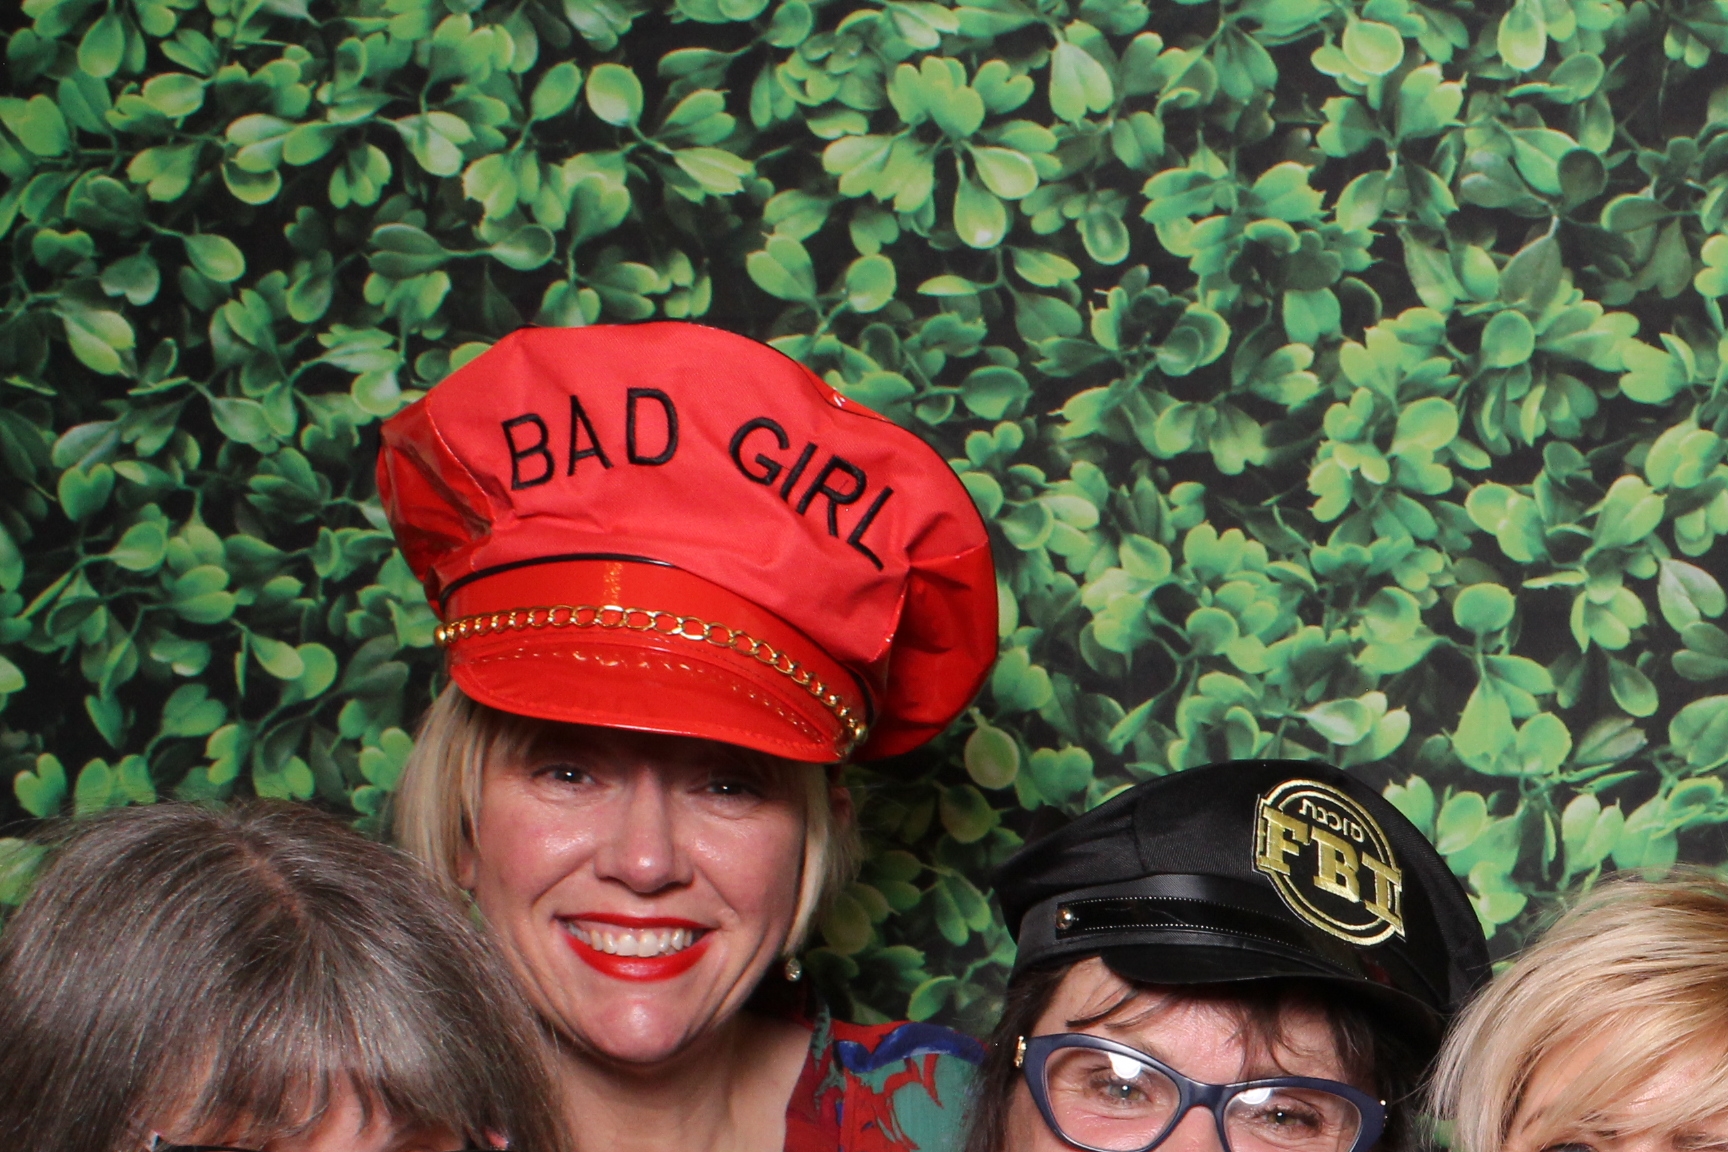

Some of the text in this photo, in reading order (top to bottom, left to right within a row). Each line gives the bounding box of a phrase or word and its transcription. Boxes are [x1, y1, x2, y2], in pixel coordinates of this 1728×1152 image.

[501, 385, 898, 572] BAD GIRL
[1257, 805, 1406, 938] FBI
